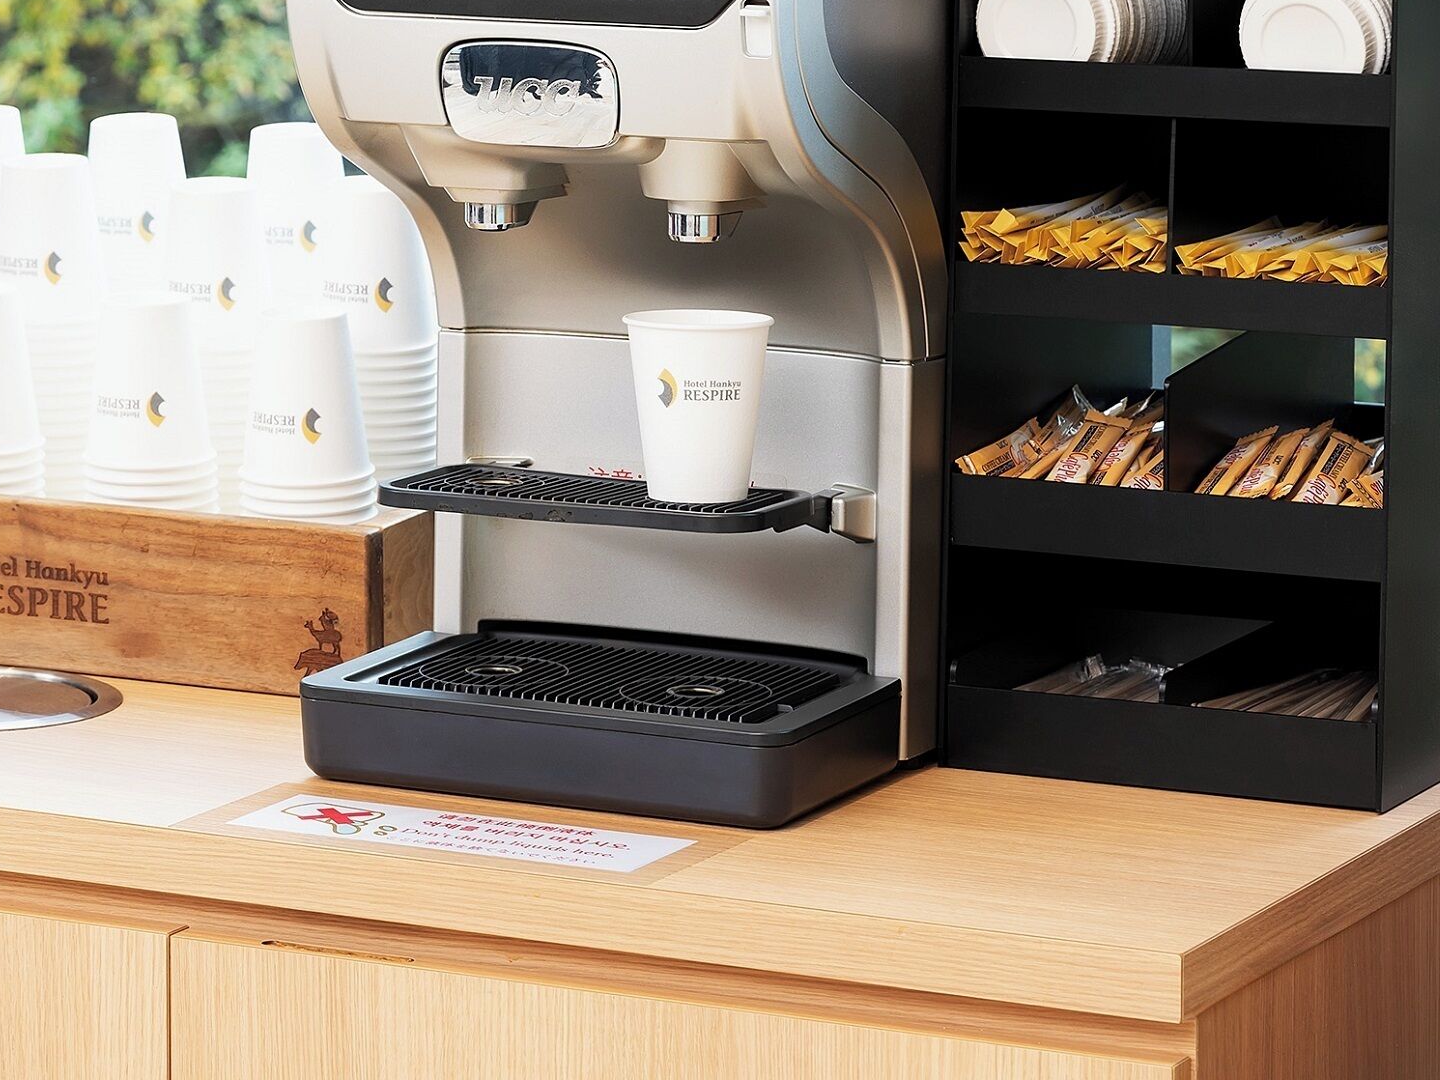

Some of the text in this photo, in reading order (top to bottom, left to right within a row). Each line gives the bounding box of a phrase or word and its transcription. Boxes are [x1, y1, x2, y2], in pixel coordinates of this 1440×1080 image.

[684, 380, 742, 389] Hotel Hankyu
[684, 389, 741, 401] RESPIRE
[25, 559, 110, 589] Hankyu
